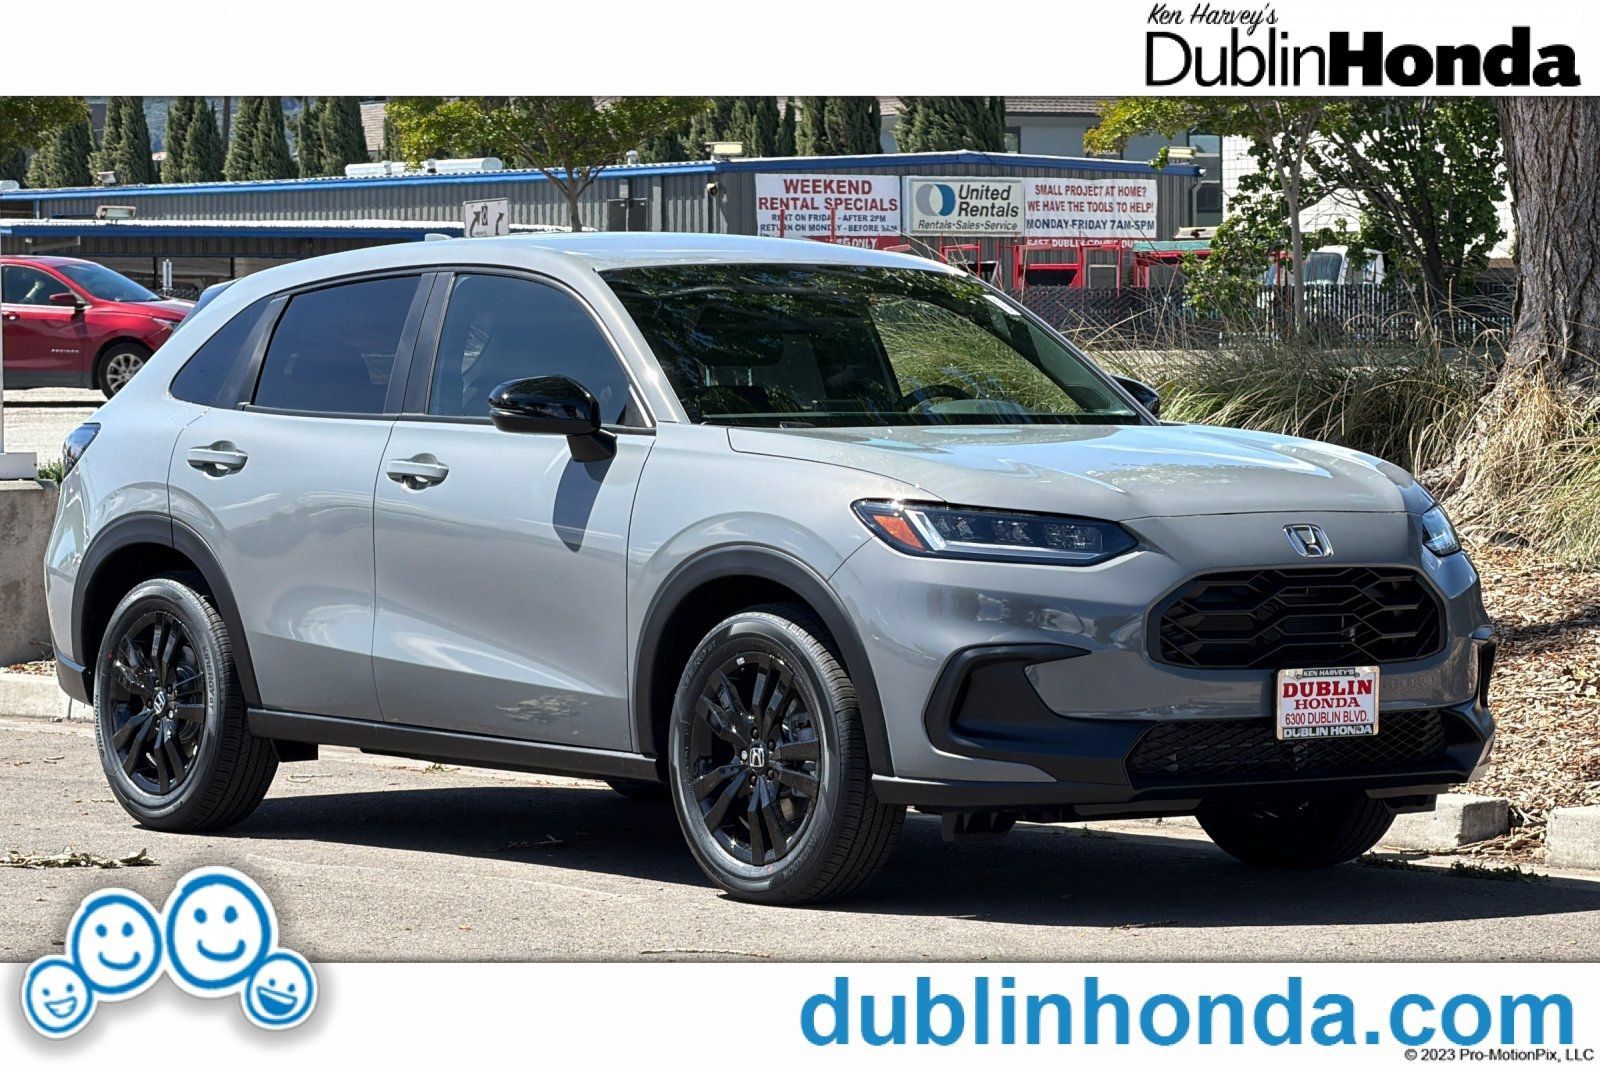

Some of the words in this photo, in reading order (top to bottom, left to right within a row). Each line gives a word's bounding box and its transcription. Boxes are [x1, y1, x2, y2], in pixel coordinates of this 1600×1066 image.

[784, 178, 872, 195] WEEKEND
[958, 184, 1012, 201] United
[1035, 184, 1062, 196] SMALL
[1065, 186, 1102, 196] PROJECT
[1106, 186, 1115, 196] AT
[1118, 186, 1146, 197] HOME?
[758, 196, 820, 210] RENTAL
[825, 197, 898, 212] SPECIALS
[958, 202, 1020, 217] Rentals
[1028, 200, 1040, 211] WE
[1043, 201, 1065, 212] HAVE
[1068, 202, 1084, 212] THE
[1087, 202, 1114, 212] TOOLS
[1117, 203, 1127, 212] TO
[1130, 202, 1154, 213] HELP!
[842, 214, 868, 222] AFTER
[1026, 219, 1107, 230] MONDAY-FRIDAY
[1110, 220, 1154, 230] 7AM-5PM
[1283, 680, 1372, 698] DUBLIN
[1294, 697, 1360, 710] HONDA
[1286, 713, 1305, 725] 6300
[1308, 711, 1340, 724] DUBLIN
[1343, 710, 1369, 723] BLVD.
[1284, 726, 1328, 738] DUBLIN
[1330, 725, 1372, 736] HONDA
